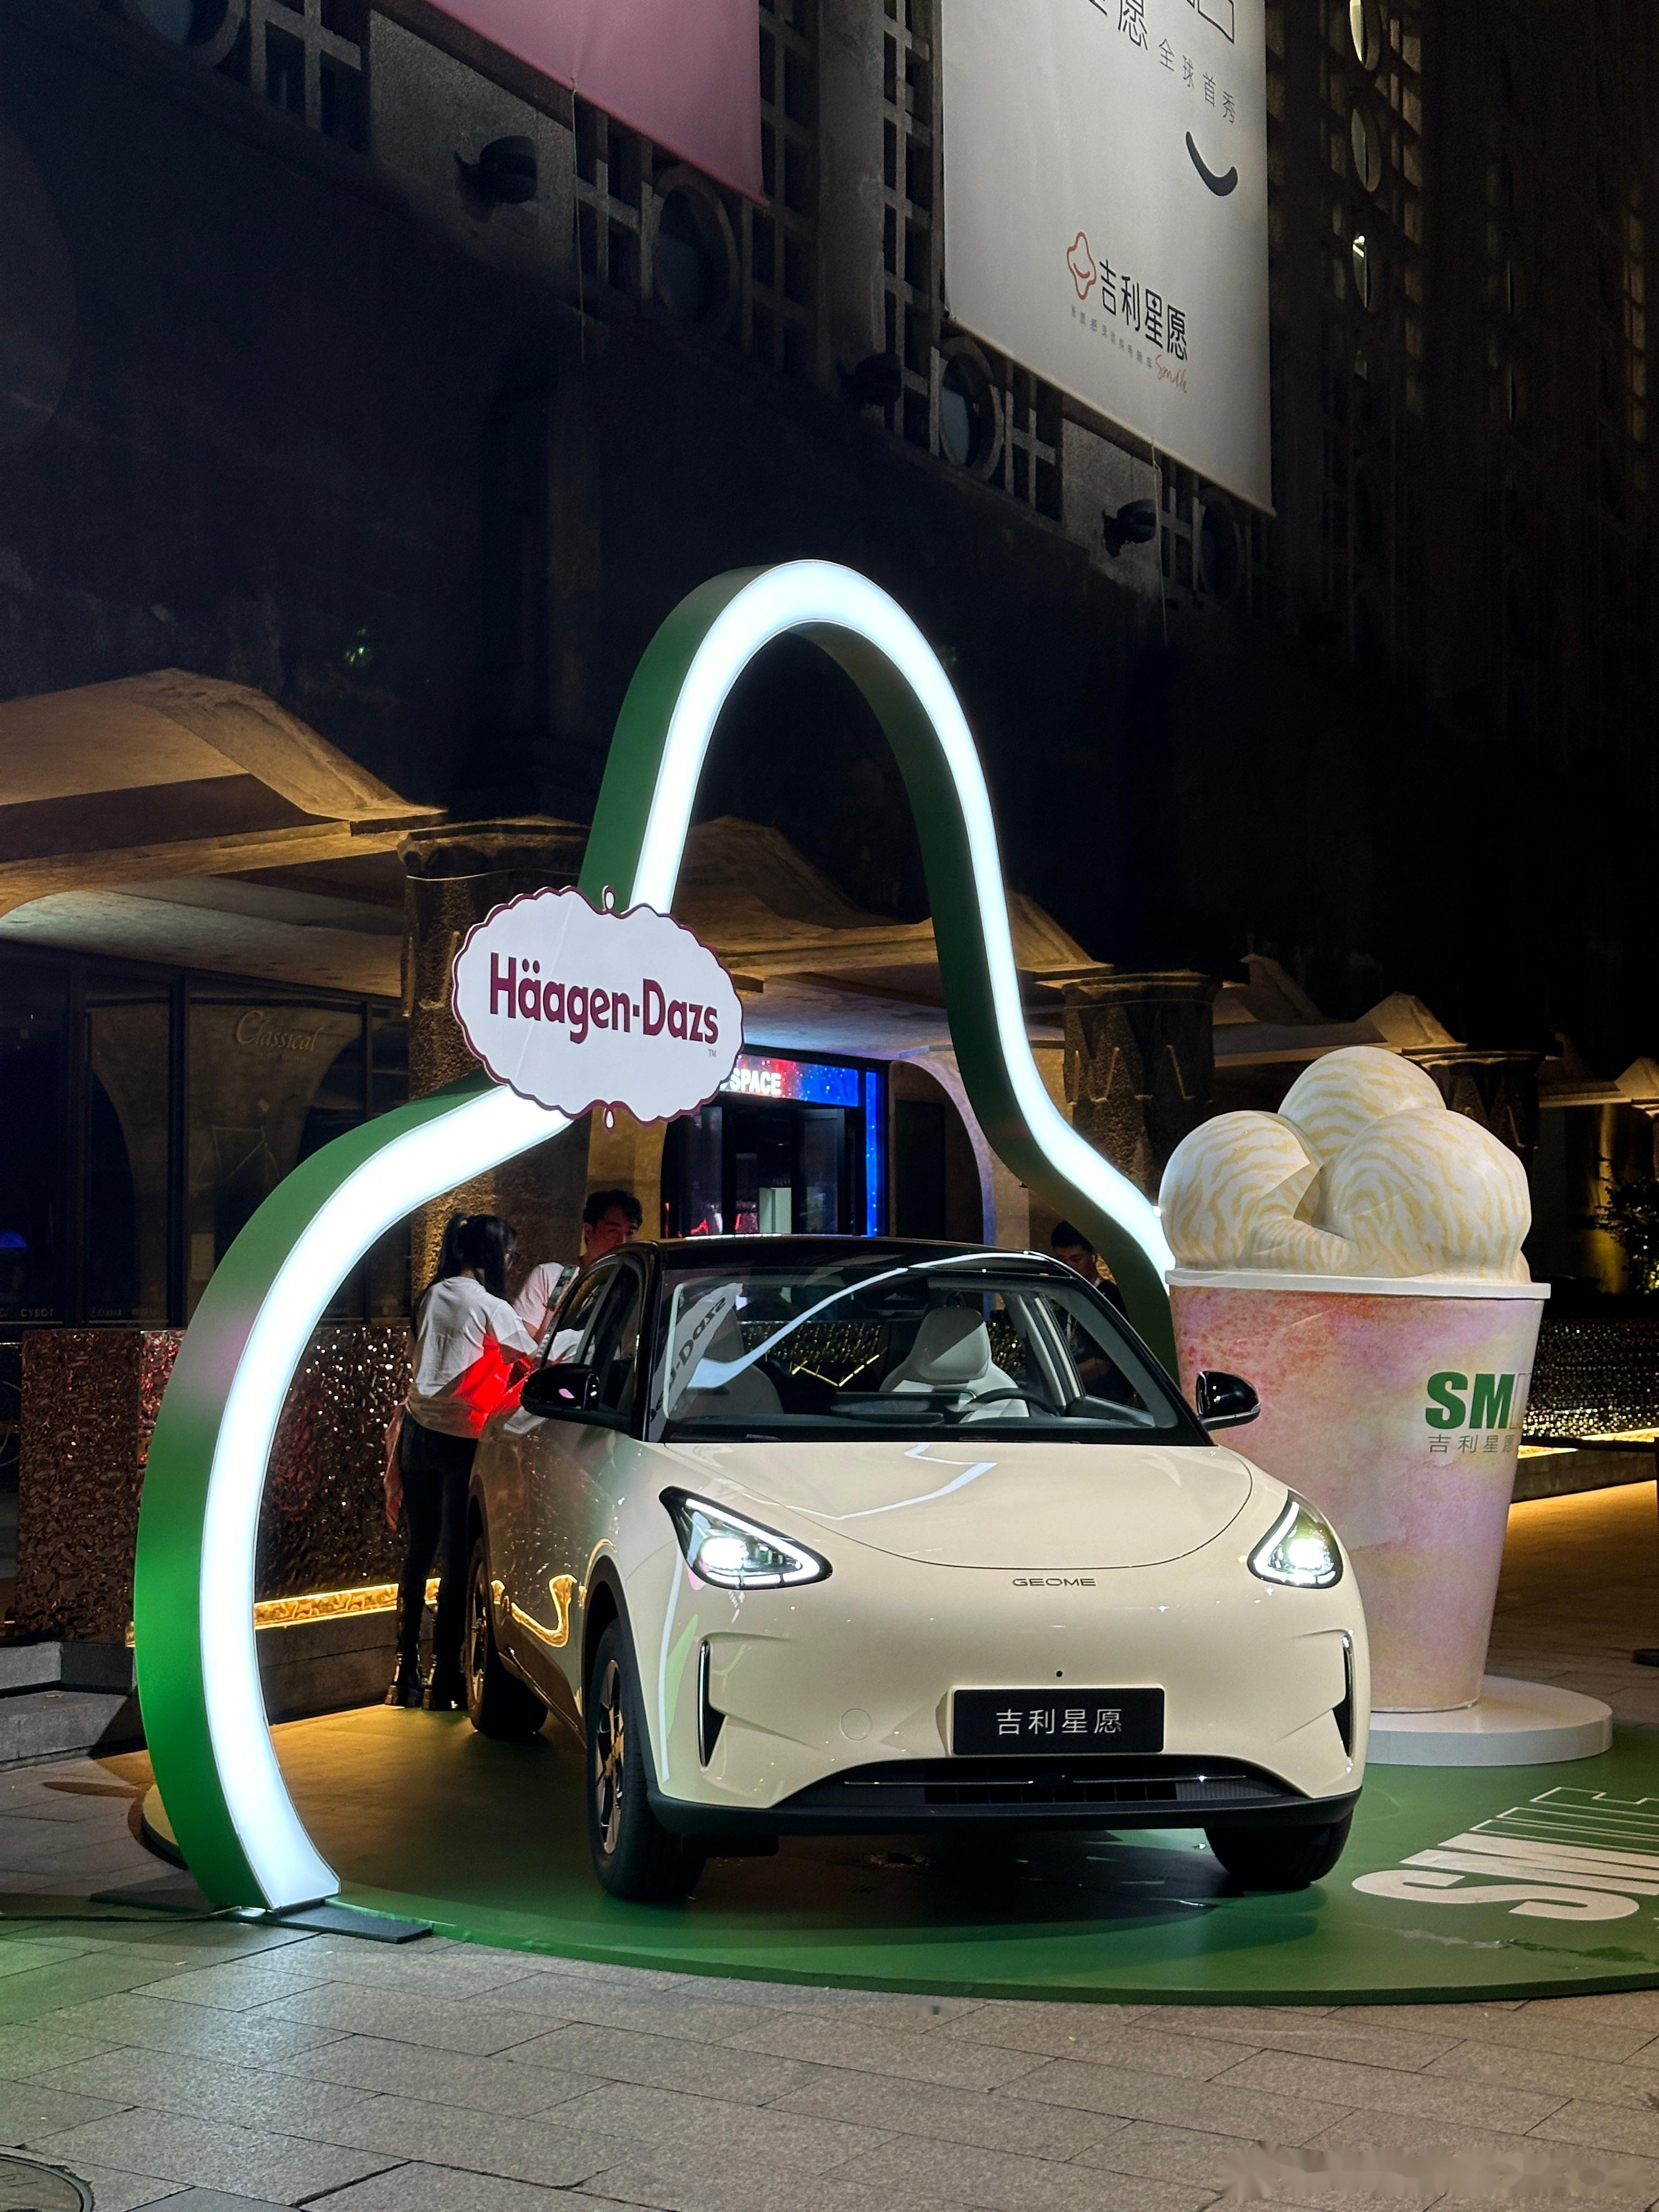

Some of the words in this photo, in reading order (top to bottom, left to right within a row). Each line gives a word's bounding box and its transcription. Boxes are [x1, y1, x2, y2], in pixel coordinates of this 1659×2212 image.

[1158, 38, 1235, 123] 全球首秀
[1099, 259, 1187, 360] 吉利星愿
[490, 952, 718, 1045] Häagen-Dazs
[236, 1010, 325, 1052] Classical
[1012, 1578, 1097, 1587] GEOME
[996, 1708, 1122, 1735] 吉利星愿
